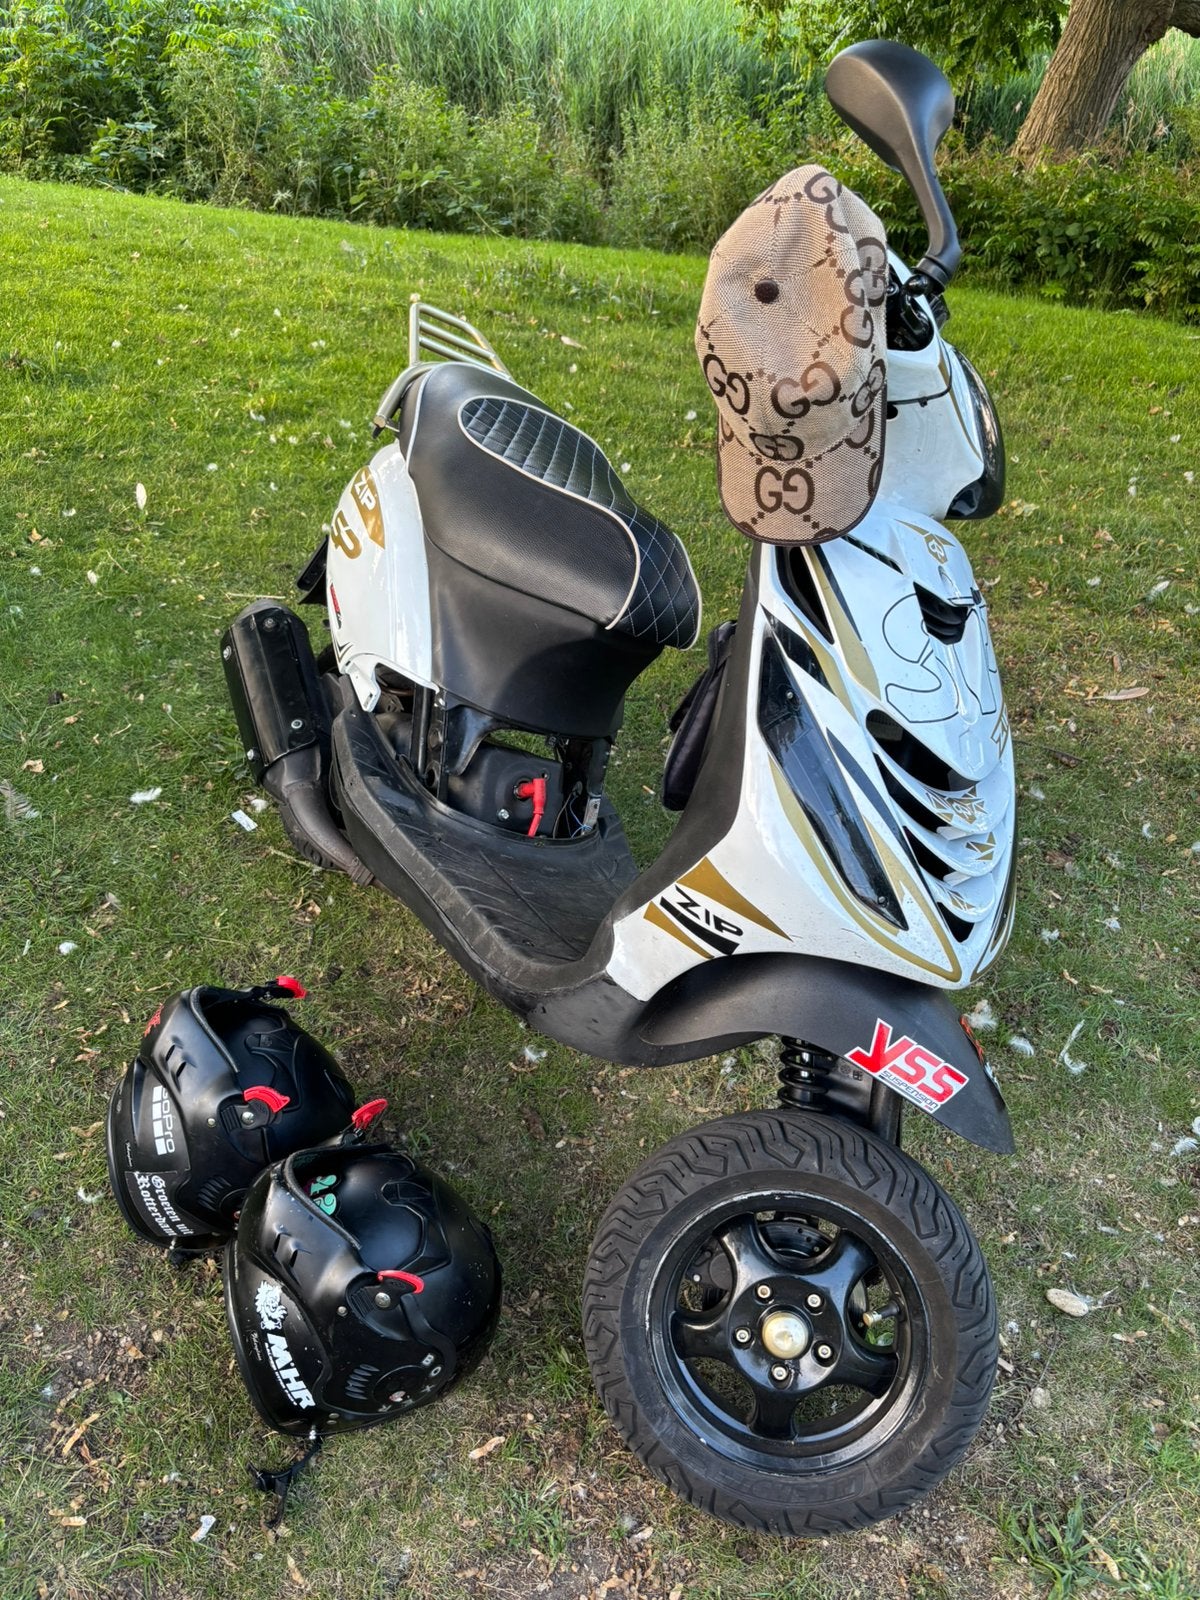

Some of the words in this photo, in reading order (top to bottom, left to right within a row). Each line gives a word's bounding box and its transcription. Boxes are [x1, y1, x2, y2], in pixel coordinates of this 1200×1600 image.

[354, 470, 377, 512] ZIP
[674, 884, 744, 937] ZIP
[847, 1022, 968, 1103] VSS
[133, 1171, 177, 1236] Rotterdam
[151, 1174, 181, 1222] Groeten
[176, 1218, 194, 1235] uit
